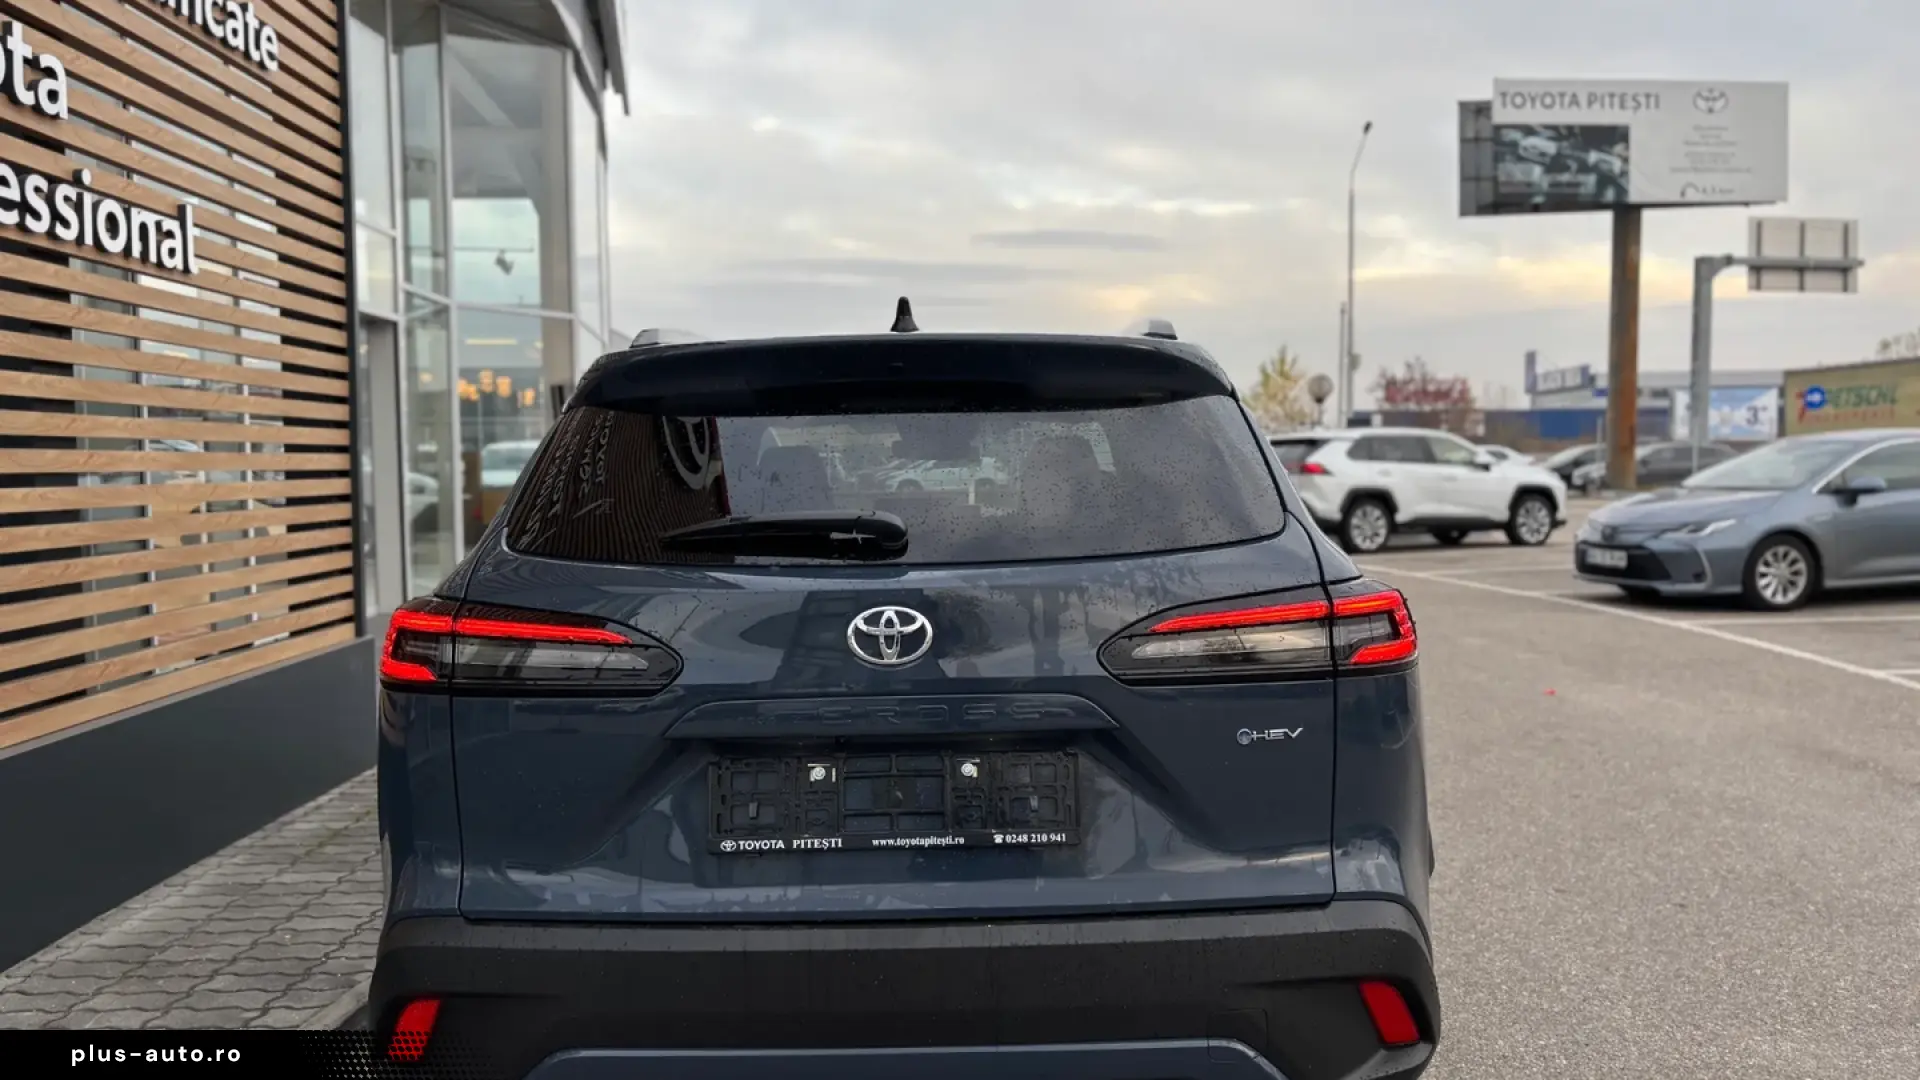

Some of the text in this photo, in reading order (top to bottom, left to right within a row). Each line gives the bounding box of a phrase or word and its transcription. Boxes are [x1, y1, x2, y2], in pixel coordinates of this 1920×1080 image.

[0, 20, 68, 120] ta
[1499, 91, 1581, 110] TOYOTA
[0, 161, 199, 274] essional
[738, 840, 785, 850] TOYOTA
[1005, 833, 1029, 843] 0248
[1031, 833, 1048, 843] 210
[1049, 833, 1067, 843] 941
